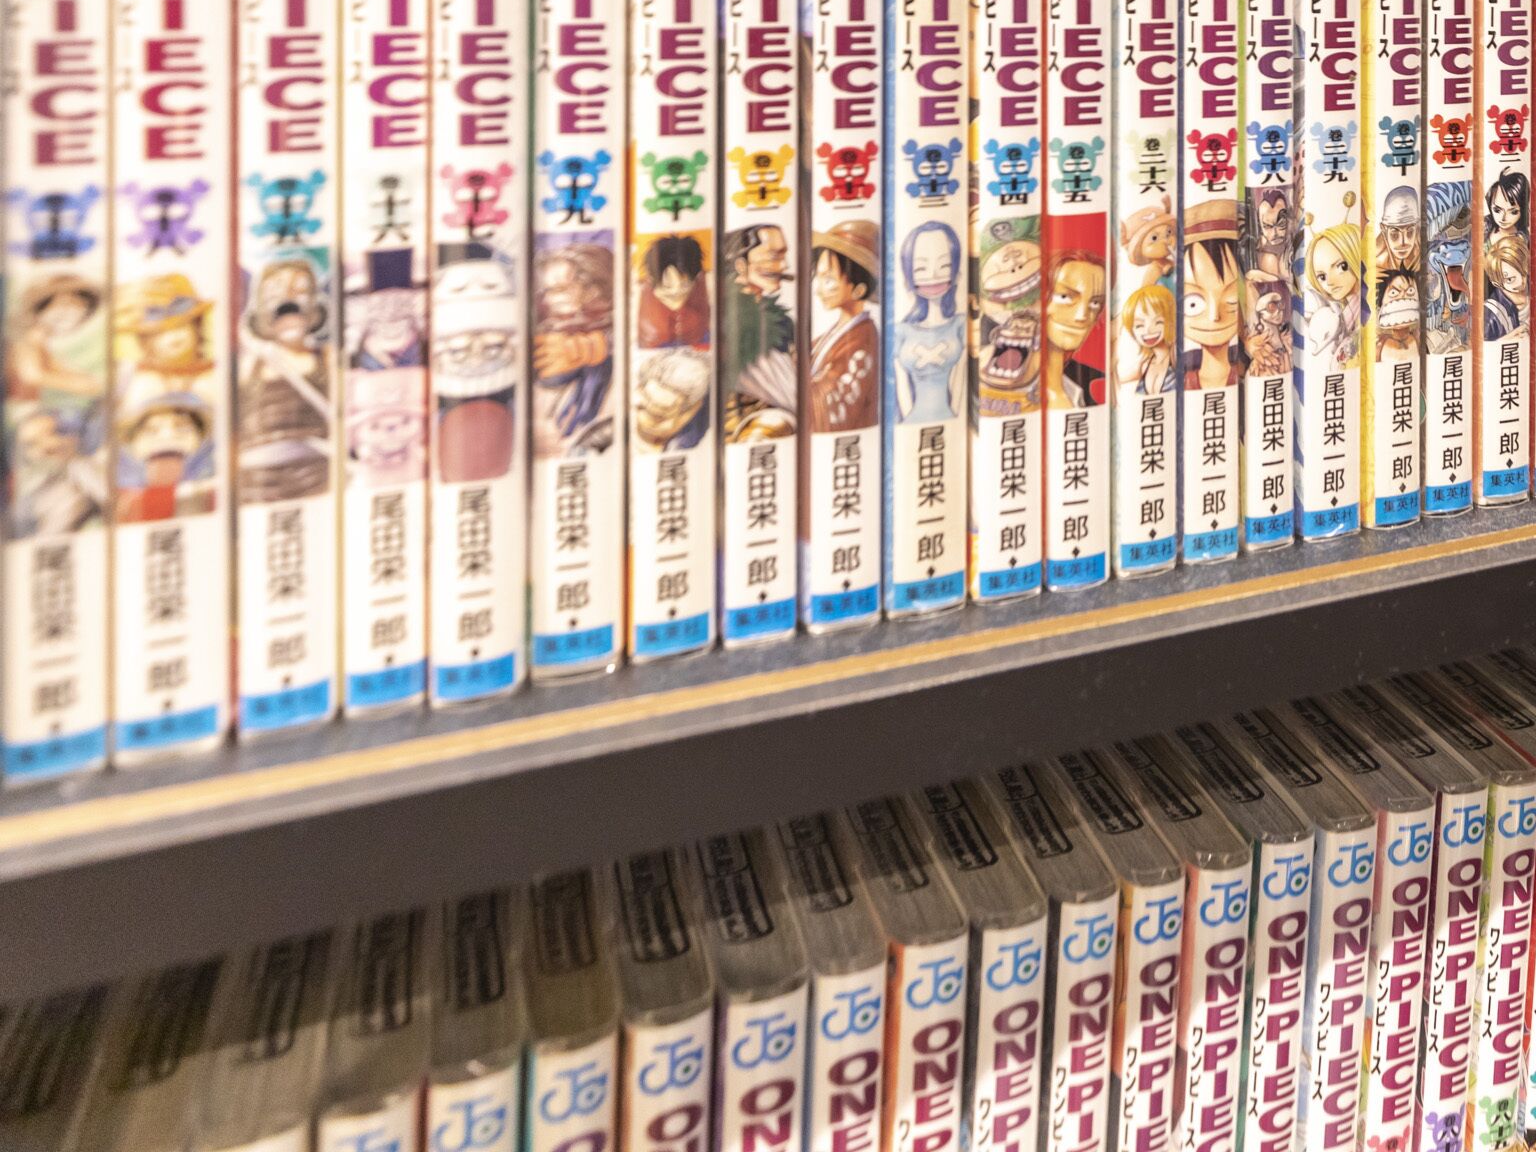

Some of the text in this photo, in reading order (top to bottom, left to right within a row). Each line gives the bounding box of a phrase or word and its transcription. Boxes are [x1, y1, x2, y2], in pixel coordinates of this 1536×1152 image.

[1140, 397, 1165, 525] 尾田栄一郎
[1202, 391, 1226, 515] 尾田栄一郎
[1323, 373, 1345, 493] 尾田栄一郎
[1392, 362, 1413, 479] 尾田栄一郎
[1442, 355, 1463, 470] 尾田栄一郎
[1500, 342, 1519, 455] 尾田栄一郎
[832, 434, 861, 574] 尾田栄一郎
[918, 425, 945, 562] 尾田栄一郎
[1000, 418, 1026, 551] 尾田栄一郎
[1063, 412, 1089, 541] 尾田栄一郎
[1382, 877, 1429, 1123] ONE PIECE
[1438, 858, 1482, 1101] ONE PIECE
[1493, 850, 1534, 1085] ONE PIECE
